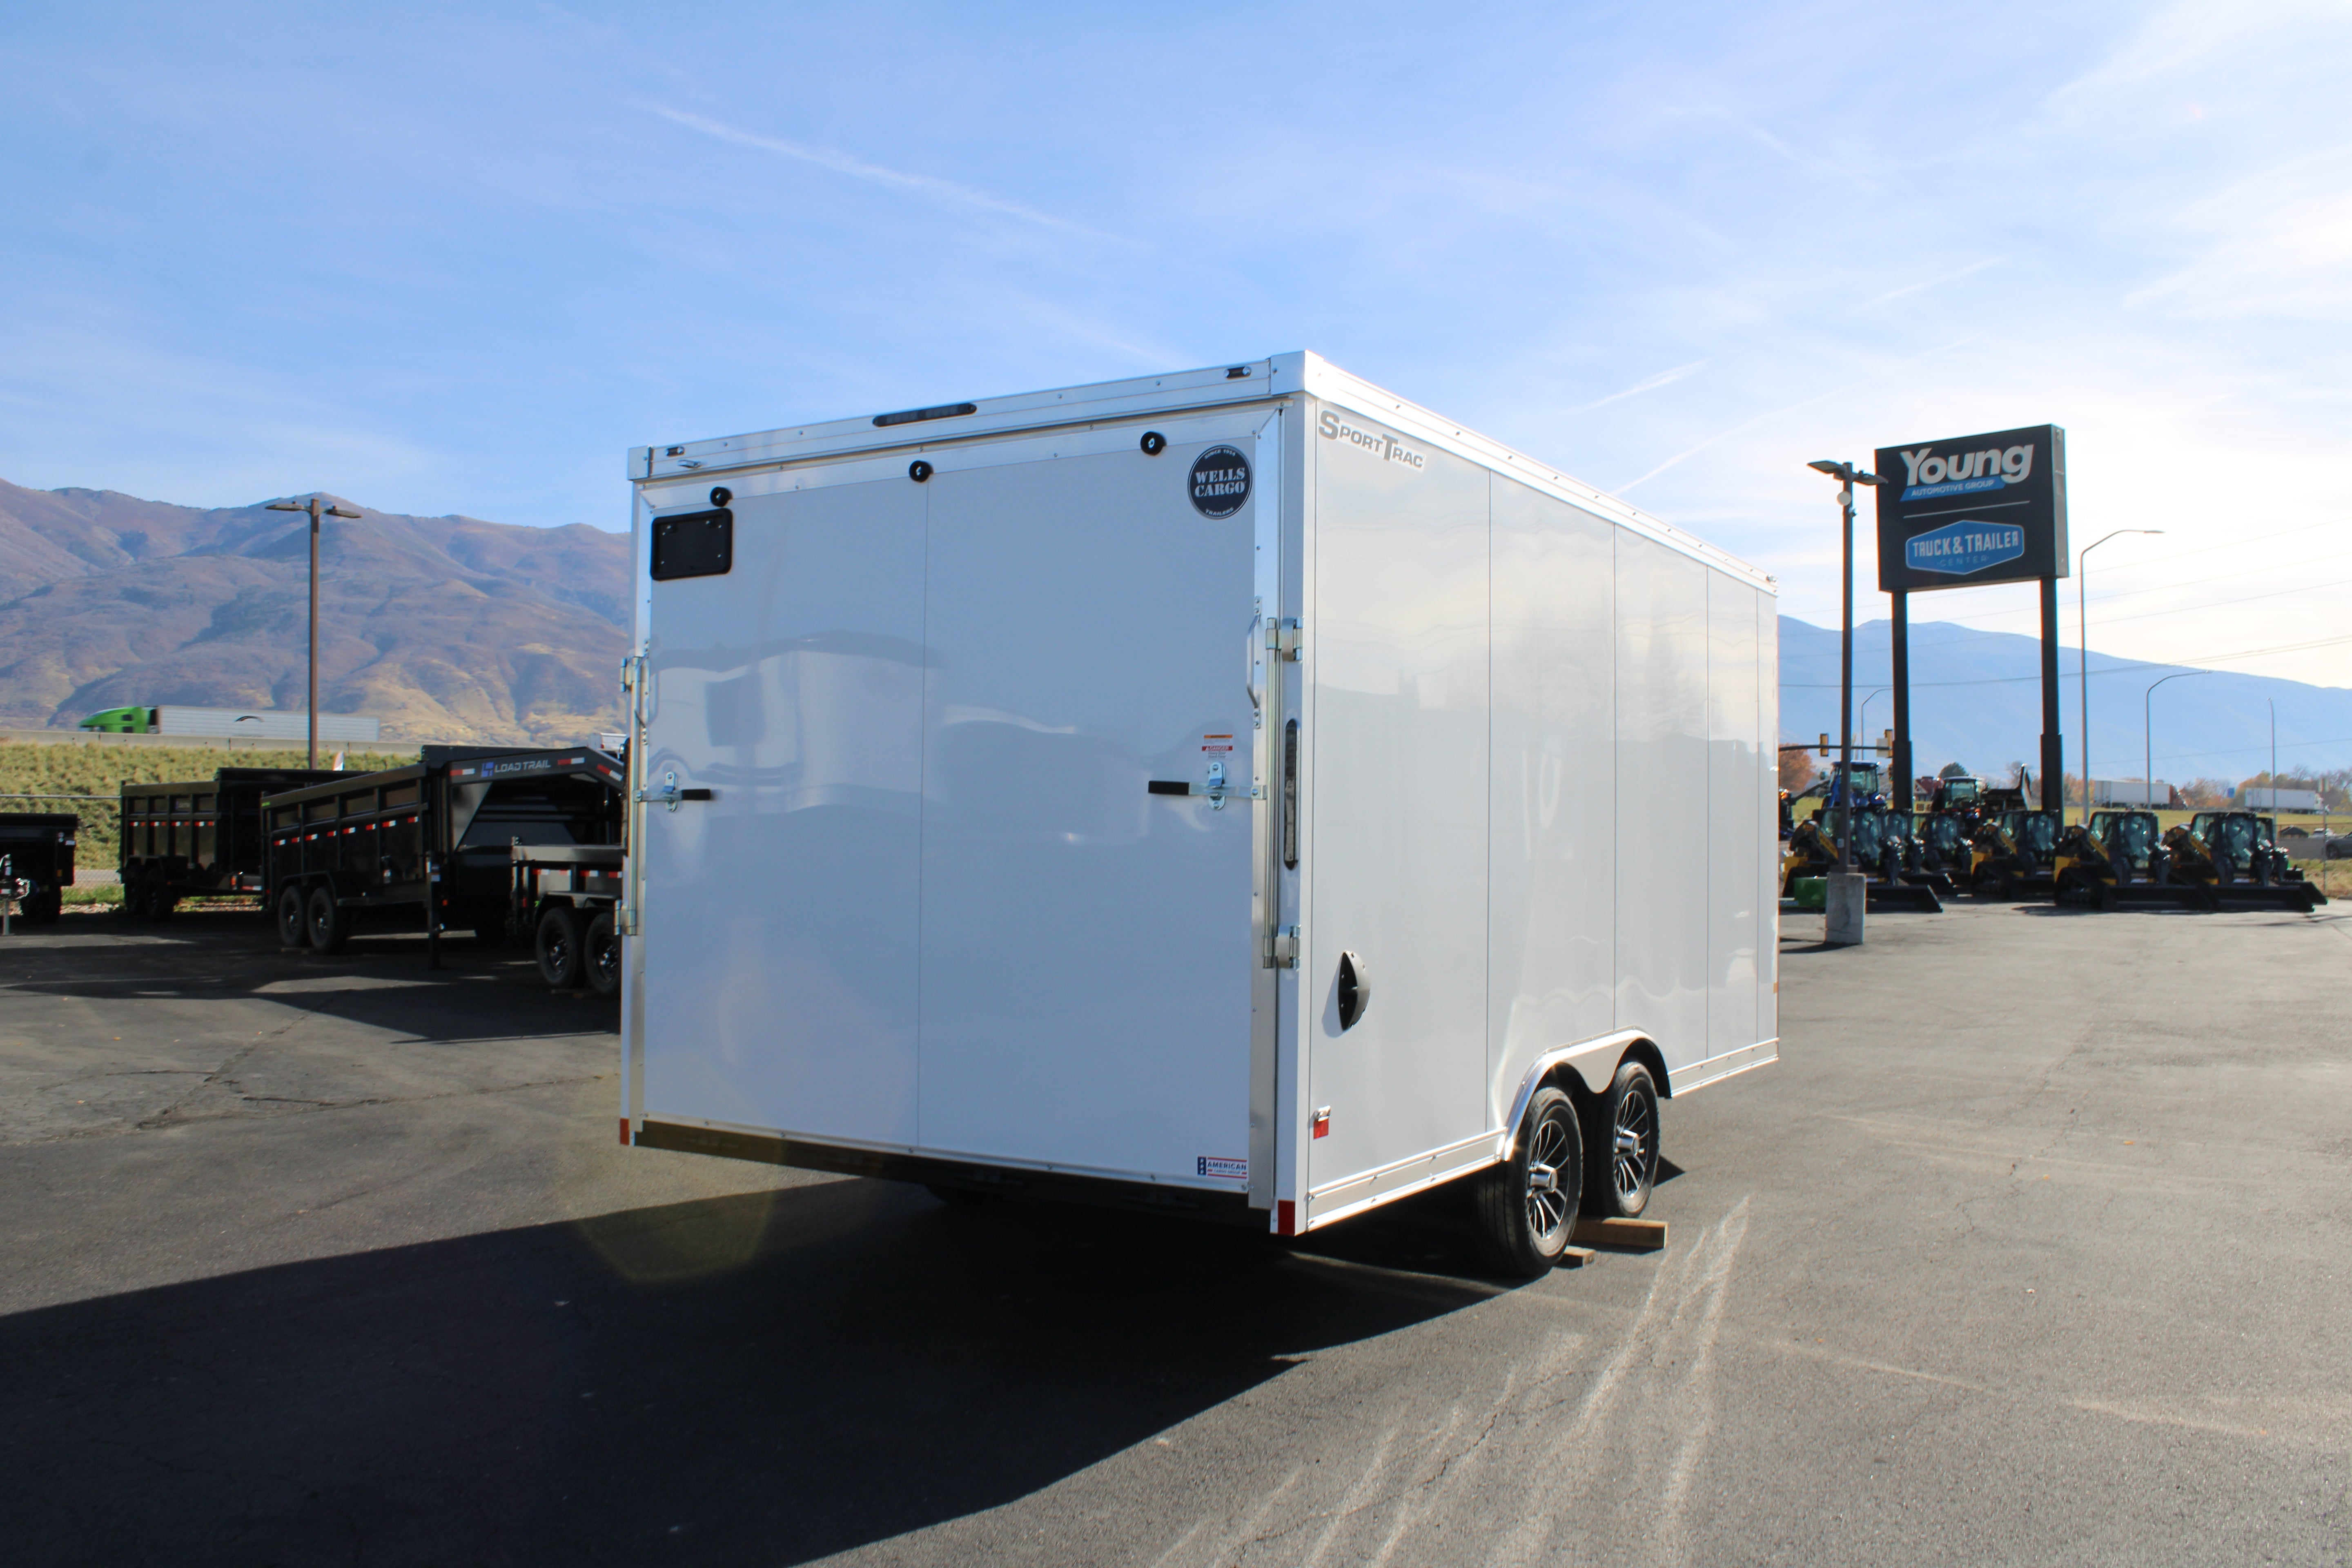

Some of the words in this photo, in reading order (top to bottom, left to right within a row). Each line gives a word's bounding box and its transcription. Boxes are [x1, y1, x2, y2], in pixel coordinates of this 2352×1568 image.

[1900, 444, 2034, 486] Young
[1195, 467, 1245, 483] WELLS
[1194, 481, 1246, 497] CARGO
[1911, 483, 1964, 496] AUTOMOTIVE
[1964, 479, 1994, 490] GROUP
[1205, 507, 1234, 516] TRAILERS
[1913, 540, 1951, 557] TRUCK
[1965, 530, 2019, 552] TRAILER
[1940, 555, 1988, 567] CENTER
[494, 762, 522, 773] LOAD
[523, 760, 552, 770] TRAIL
[1207, 1161, 1247, 1170] AMERICAN
